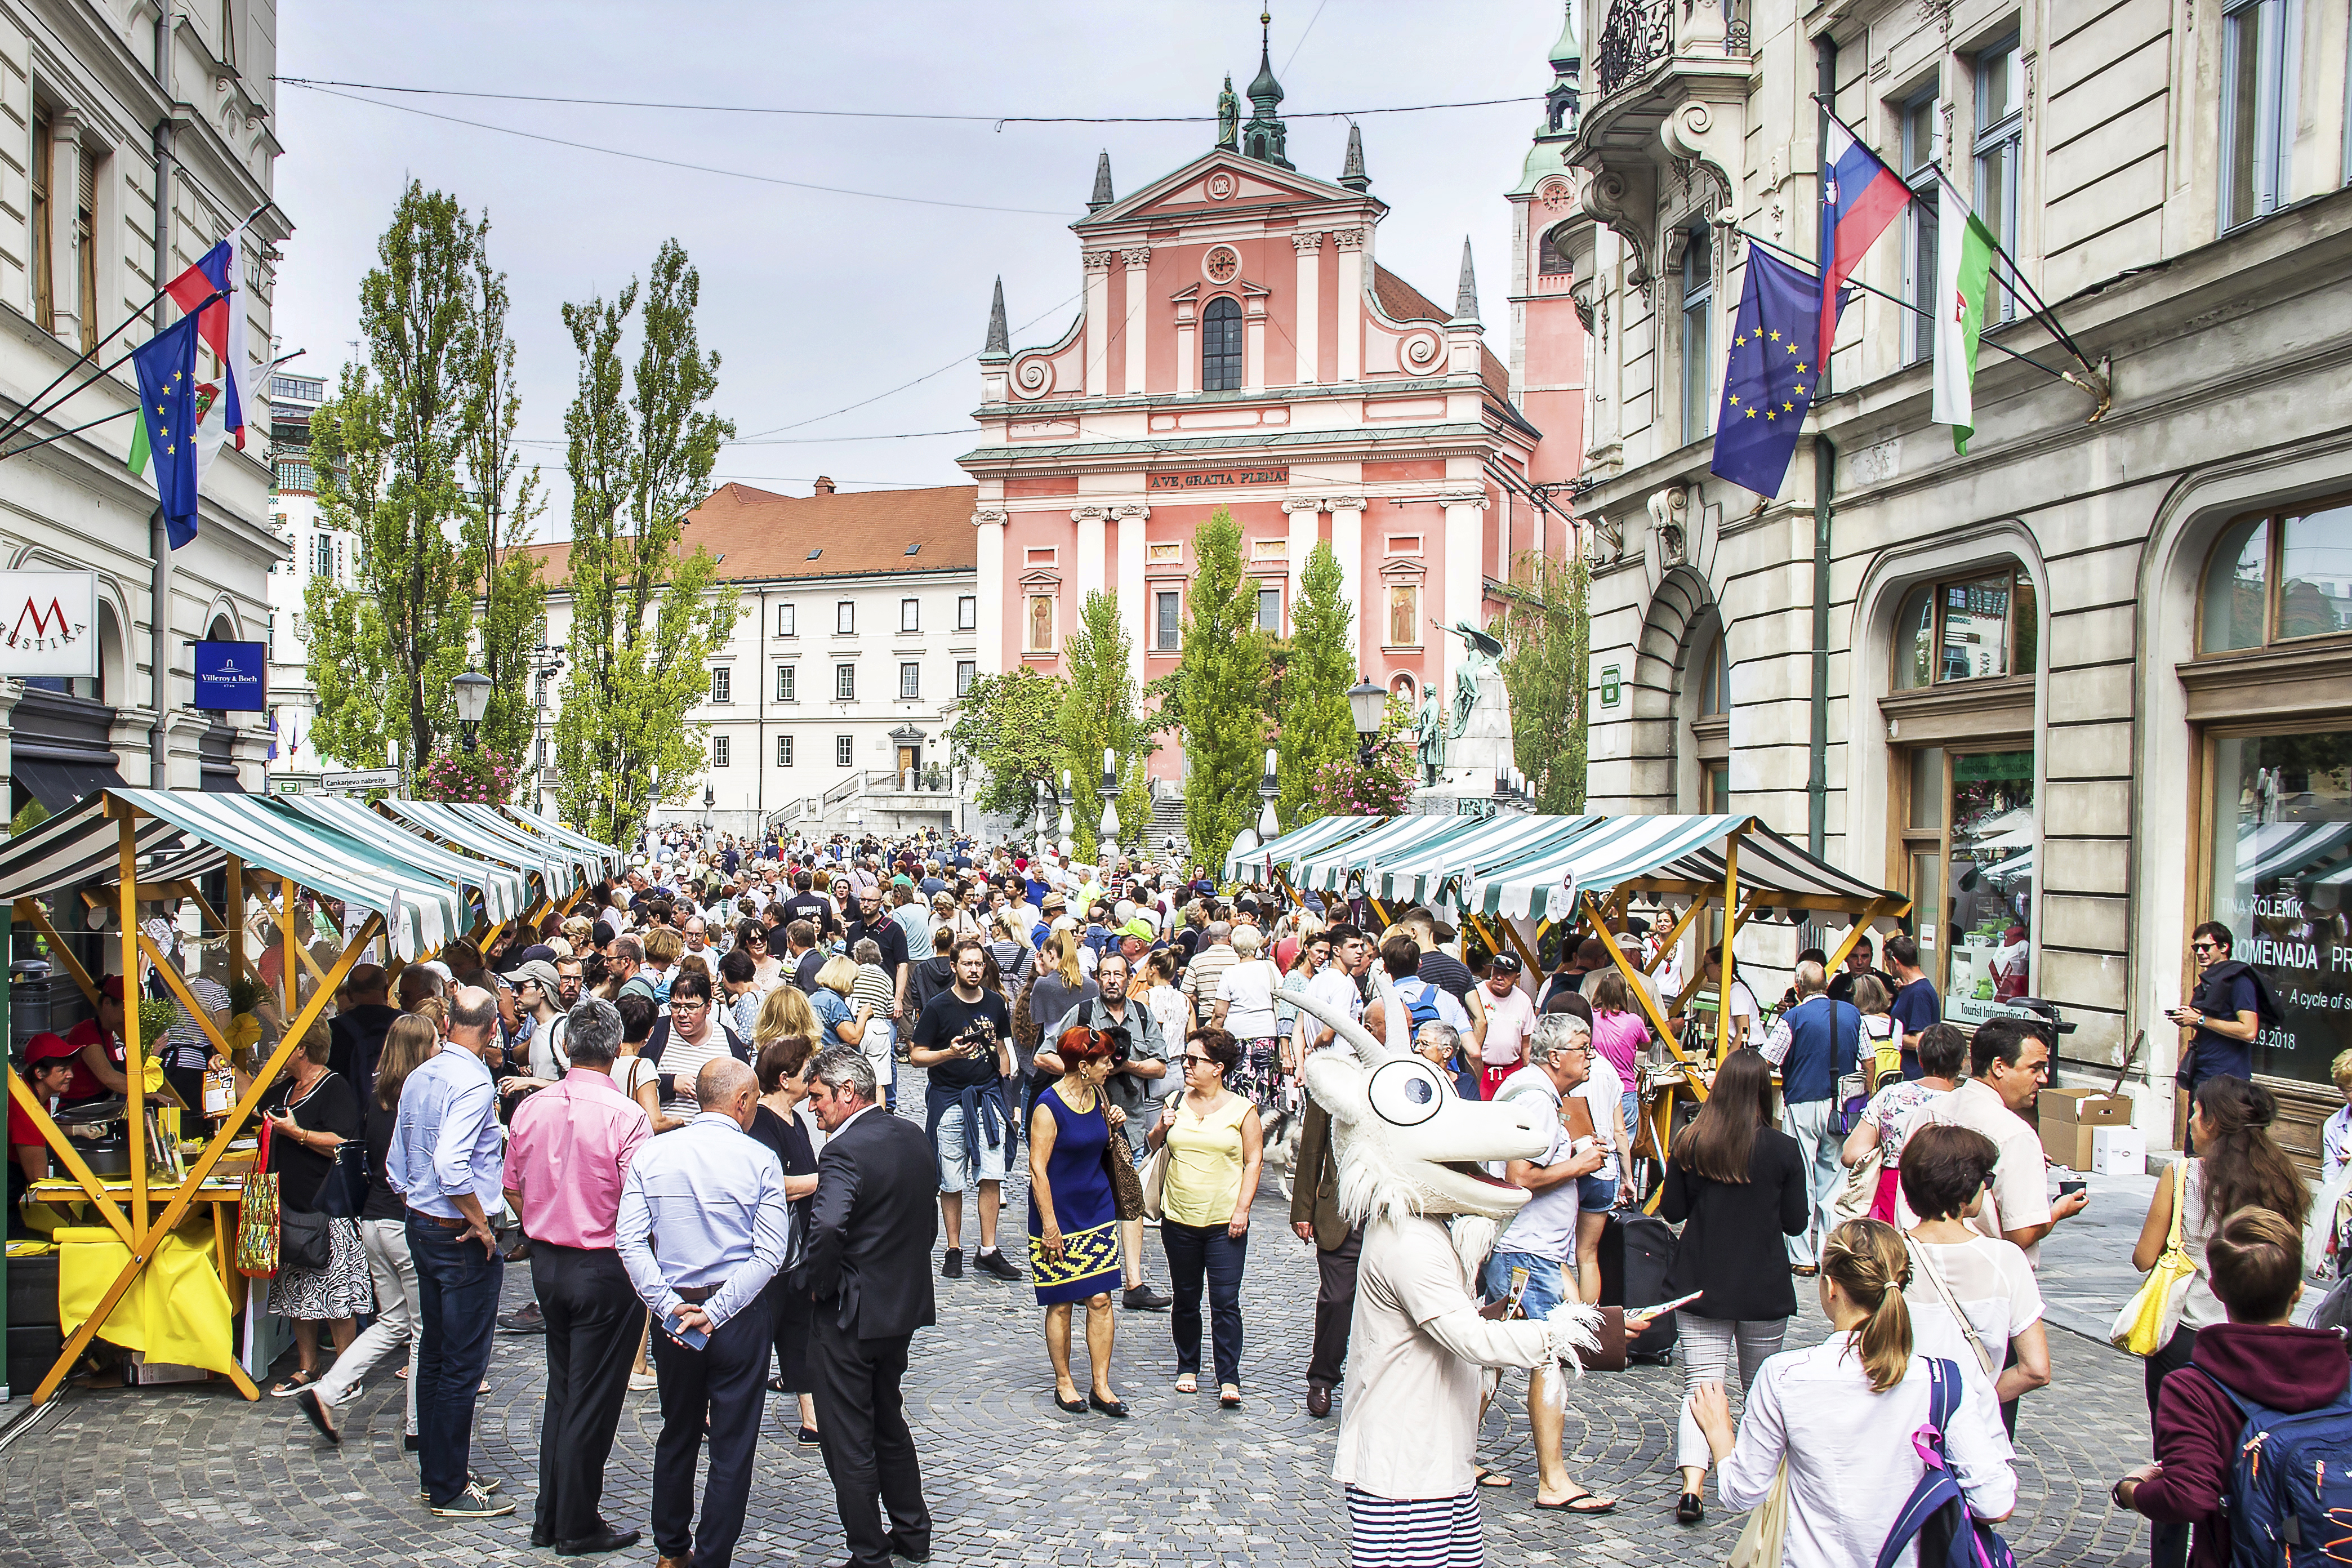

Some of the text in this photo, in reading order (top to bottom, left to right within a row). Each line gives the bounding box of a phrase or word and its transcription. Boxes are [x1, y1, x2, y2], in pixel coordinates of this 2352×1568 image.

[1186, 473, 1235, 485] GRATIA
[202, 674, 231, 683] Villeroy
[326, 777, 386, 787] Cankarjevo nabrežje
[2220, 898, 2304, 919] TINA KOLENIK
[2289, 988, 2297, 1004] A
[2300, 991, 2328, 1009] cycle
[2331, 993, 2344, 1008] of
[1961, 1003, 1982, 1018] Tourist
[2251, 1030, 2295, 1050] .9.2018
